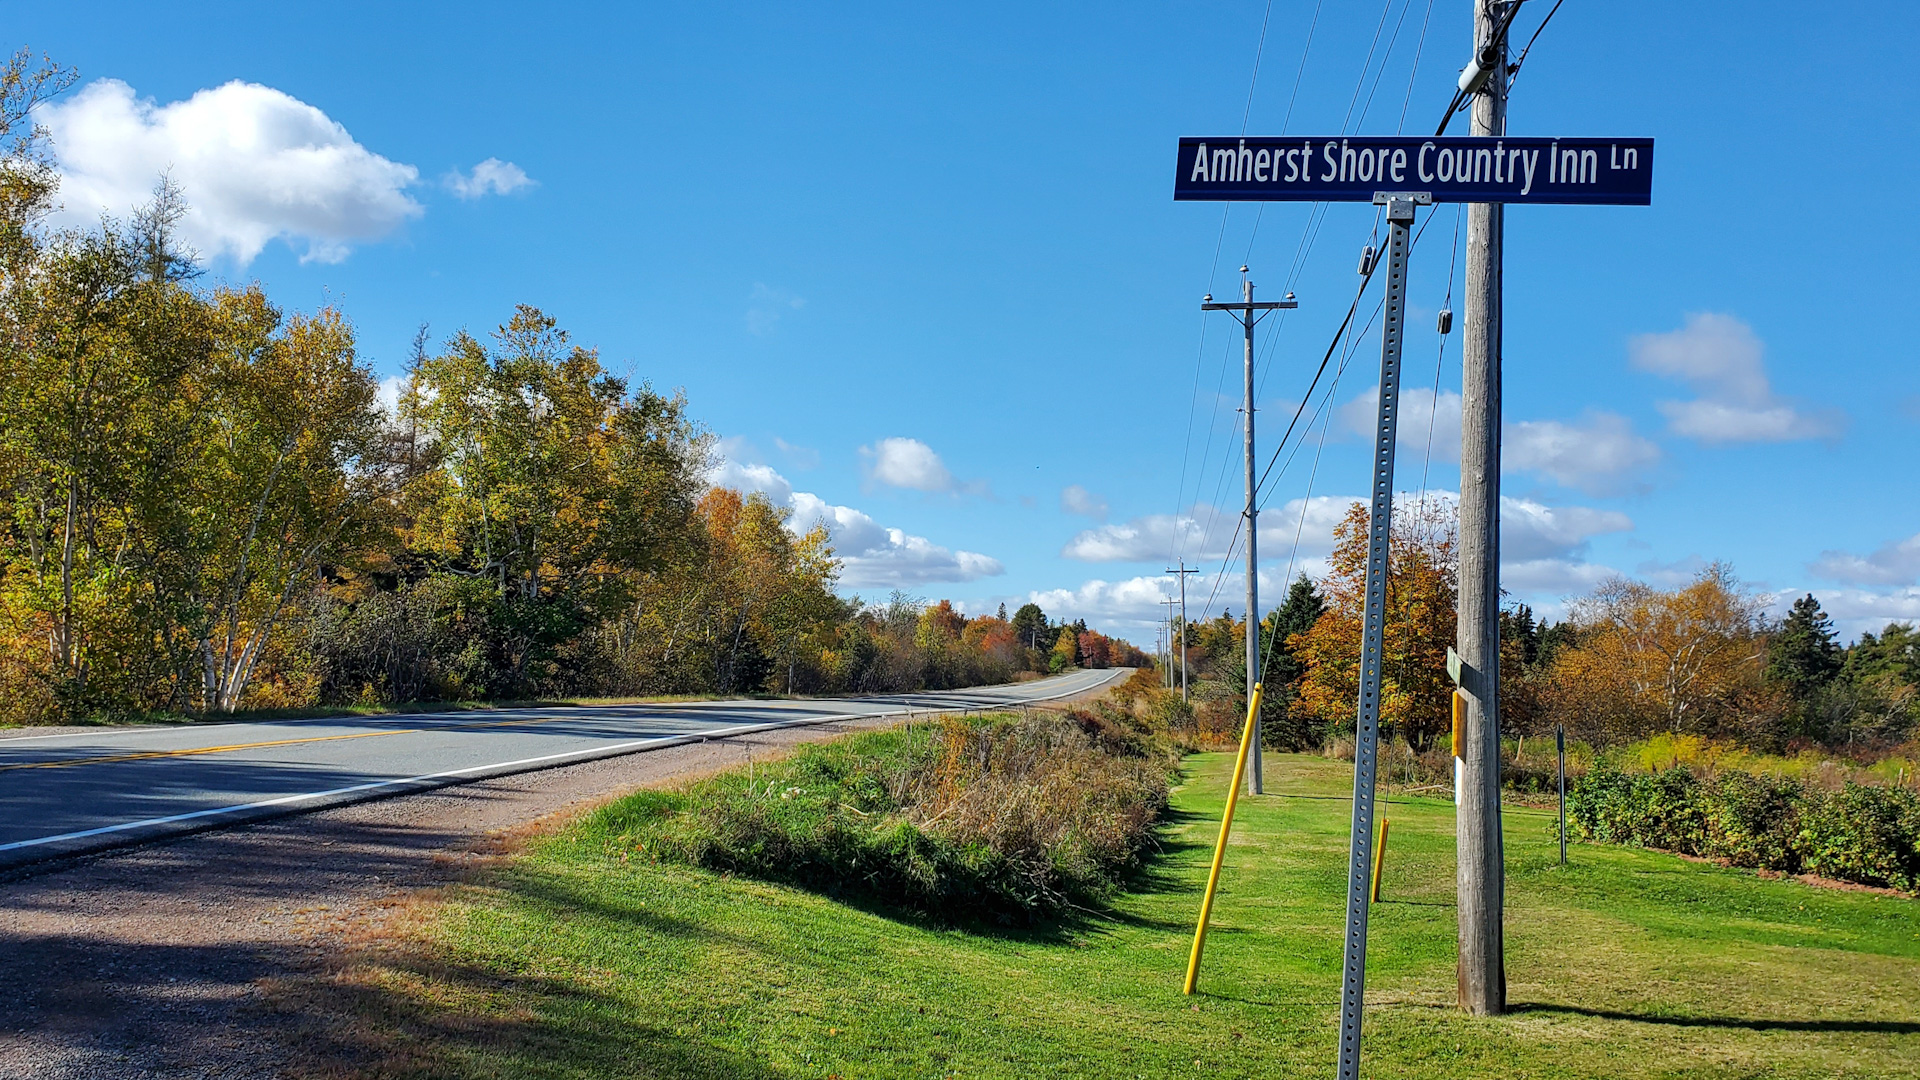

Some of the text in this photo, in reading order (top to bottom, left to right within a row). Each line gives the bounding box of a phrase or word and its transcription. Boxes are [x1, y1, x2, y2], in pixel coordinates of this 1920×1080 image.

[1191, 139, 1638, 196] Amherst Shore Country Inn Ln
